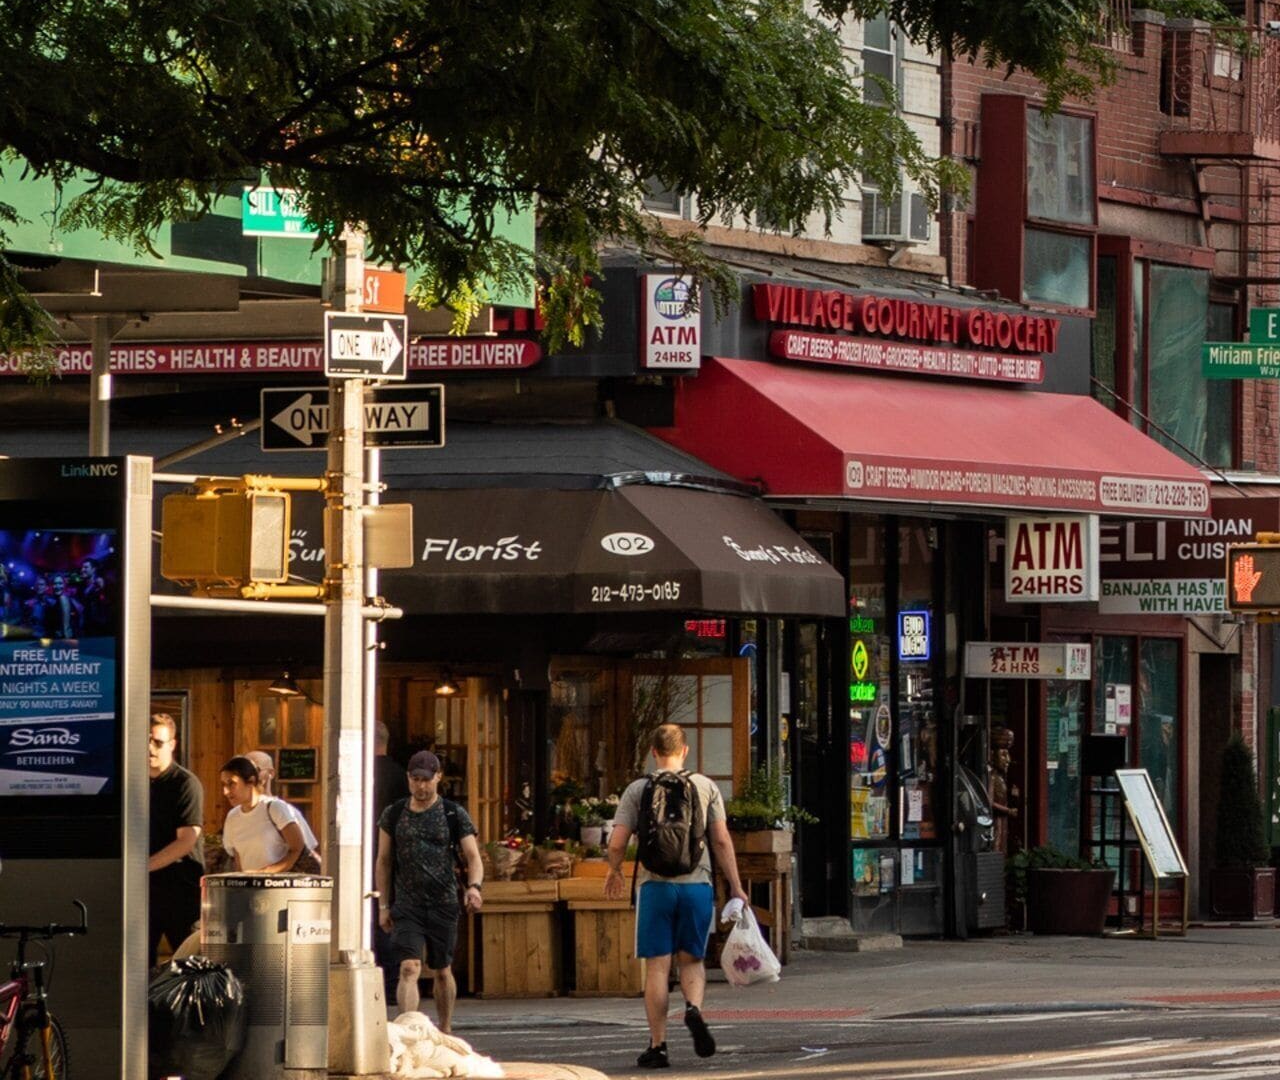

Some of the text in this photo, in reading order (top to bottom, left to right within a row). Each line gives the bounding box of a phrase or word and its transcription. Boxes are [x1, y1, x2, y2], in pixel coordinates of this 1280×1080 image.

[365, 275, 380, 306] St
[766, 283, 1061, 353] VILLAGE GOURMET GROCERY
[1268, 314, 1277, 338] E
[650, 326, 697, 345] ATM
[339, 334, 394, 356] ONE WAY
[60, 344, 525, 370] GROERIES HEALTH & BEAUTY FREE DELIVERY
[654, 351, 693, 363] 24HRS
[788, 335, 810, 356] CRAFT
[810, 338, 834, 359] BEERS
[837, 341, 863, 361] FROZEN
[863, 344, 883, 364] FOODS
[886, 347, 919, 368] GROCERIES
[923, 350, 946, 371] HEALTH
[979, 356, 998, 376] LOTTO
[1002, 357, 1015, 378] FREE
[1016, 359, 1041, 379] DELIVERY
[1209, 347, 1252, 365] Miriam
[1260, 367, 1280, 377] Way
[290, 406, 418, 430] ON WAY
[61, 463, 118, 477] LinkNYC
[866, 465, 886, 486] CRAFT
[887, 467, 907, 488] BEERS
[911, 468, 939, 490] HUMIDOR
[940, 470, 962, 491] CIGARS
[966, 472, 991, 493] FOREIGN
[993, 473, 1026, 496] MAGAZINES
[1030, 476, 1056, 497] SMOKING
[1057, 477, 1096, 501] ACCESSORIES
[1102, 482, 1117, 501] FREE
[1119, 483, 1148, 504] DELIVERY
[1184, 518, 1252, 537] INDIAN
[422, 535, 543, 561] Florist
[609, 537, 649, 551] 102
[1012, 522, 1083, 570] ATM
[1177, 542, 1240, 560] CUIS
[592, 581, 680, 602] 212-473-0185
[1011, 575, 1083, 595] 24HRS
[1103, 581, 1208, 596] BANJARA HAS
[1140, 598, 1227, 612] WITH HAVE
[903, 615, 925, 635] BUD
[901, 635, 928, 655] LIGHT
[991, 647, 1040, 661] ATM
[13, 649, 79, 662] FREE, LIVE
[0, 663, 101, 675] NTERTAINMENT
[991, 662, 1040, 673] 24 HRS
[3, 681, 100, 693] NIGHTS A WEEK!
[20, 701, 30, 709] 90
[31, 700, 69, 709] MINUTES
[70, 700, 98, 708] AWAY!
[8, 728, 80, 745] Sands
[17, 756, 75, 765] BETHLEHEM
[265, 879, 290, 887] Don't
